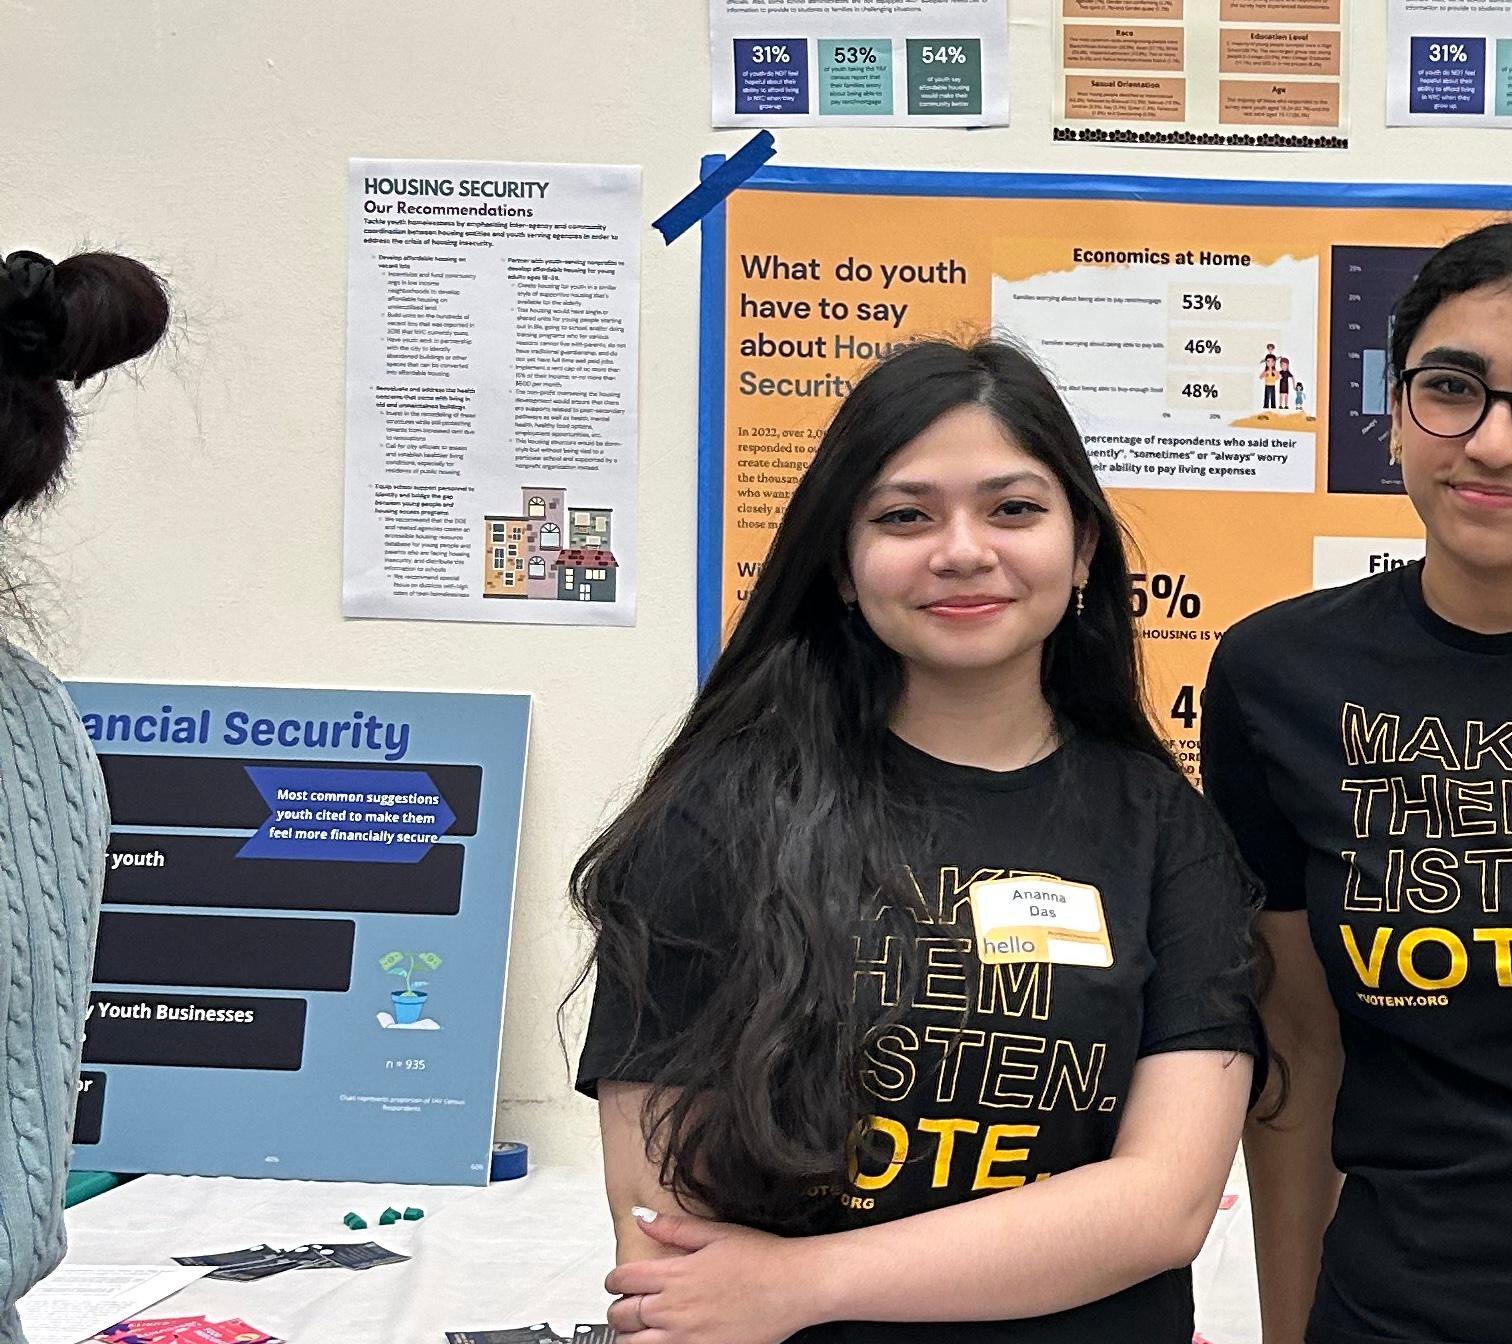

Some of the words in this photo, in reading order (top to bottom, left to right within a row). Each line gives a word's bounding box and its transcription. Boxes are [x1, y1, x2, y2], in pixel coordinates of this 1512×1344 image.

[752, 44, 790, 64] 31%
[833, 46, 877, 65] 53%
[921, 46, 967, 65] 54%
[1429, 44, 1468, 62] 31%
[364, 178, 454, 196] HOUSING
[458, 180, 549, 198] SECURITY
[364, 200, 393, 214] Our
[397, 201, 534, 218] Recommendations
[1073, 248, 1170, 265] Economics
[1175, 250, 1195, 265] at
[1200, 251, 1251, 266] Home
[740, 254, 820, 281] What
[835, 256, 872, 282] do
[880, 259, 967, 290] youth
[740, 293, 811, 319] have
[818, 297, 849, 321] to
[856, 304, 908, 329] say
[1182, 294, 1222, 311] 53%
[740, 332, 826, 358] about
[1184, 339, 1222, 355] 46%
[1182, 383, 1219, 399] 48%
[738, 427, 749, 437] In
[751, 427, 780, 439] 2022,
[782, 429, 805, 438] over
[1084, 434, 1142, 448] percentage
[1144, 434, 1156, 446] of
[1157, 435, 1222, 448] respondents
[1223, 437, 1245, 448] who
[1247, 437, 1270, 448] said
[1271, 438, 1297, 449] their
[738, 443, 792, 454] responded
[794, 445, 806, 454] to
[738, 459, 770, 468] create
[1197, 452, 1208, 461] or
[1257, 453, 1289, 464] worry
[737, 474, 755, 483] the
[1109, 463, 1142, 475] ability
[1144, 464, 1155, 474] to
[1157, 466, 1177, 477] pay
[1178, 464, 1206, 476] living
[1208, 466, 1257, 477] expenses
[737, 489, 761, 498] who
[737, 503, 772, 515] closely
[737, 518, 767, 529] those
[1142, 629, 1197, 640] HOUSING
[1200, 630, 1211, 640] IS
[82, 705, 210, 744] ancial
[223, 710, 410, 761] Security
[277, 788, 308, 802] Most
[310, 790, 363, 804] common
[366, 792, 440, 806] suggestions
[275, 808, 313, 822] youth
[315, 809, 346, 822] cited
[348, 811, 362, 822] to
[364, 810, 399, 823] make
[402, 811, 435, 824] them
[269, 827, 293, 839] feel
[295, 830, 328, 841] more
[330, 829, 395, 845] financially
[397, 832, 438, 844] secure
[111, 851, 165, 868] youth
[1012, 889, 1066, 904] Ananna
[1029, 905, 1057, 918] Das
[983, 936, 1036, 954] hello
[853, 935, 1052, 1021] HEM
[98, 1002, 152, 1019] Youth
[156, 1004, 254, 1023] Businesses
[405, 1059, 426, 1070] 935
[859, 1023, 1117, 1112] STEN.
[847, 1114, 1052, 1191] OTE.
